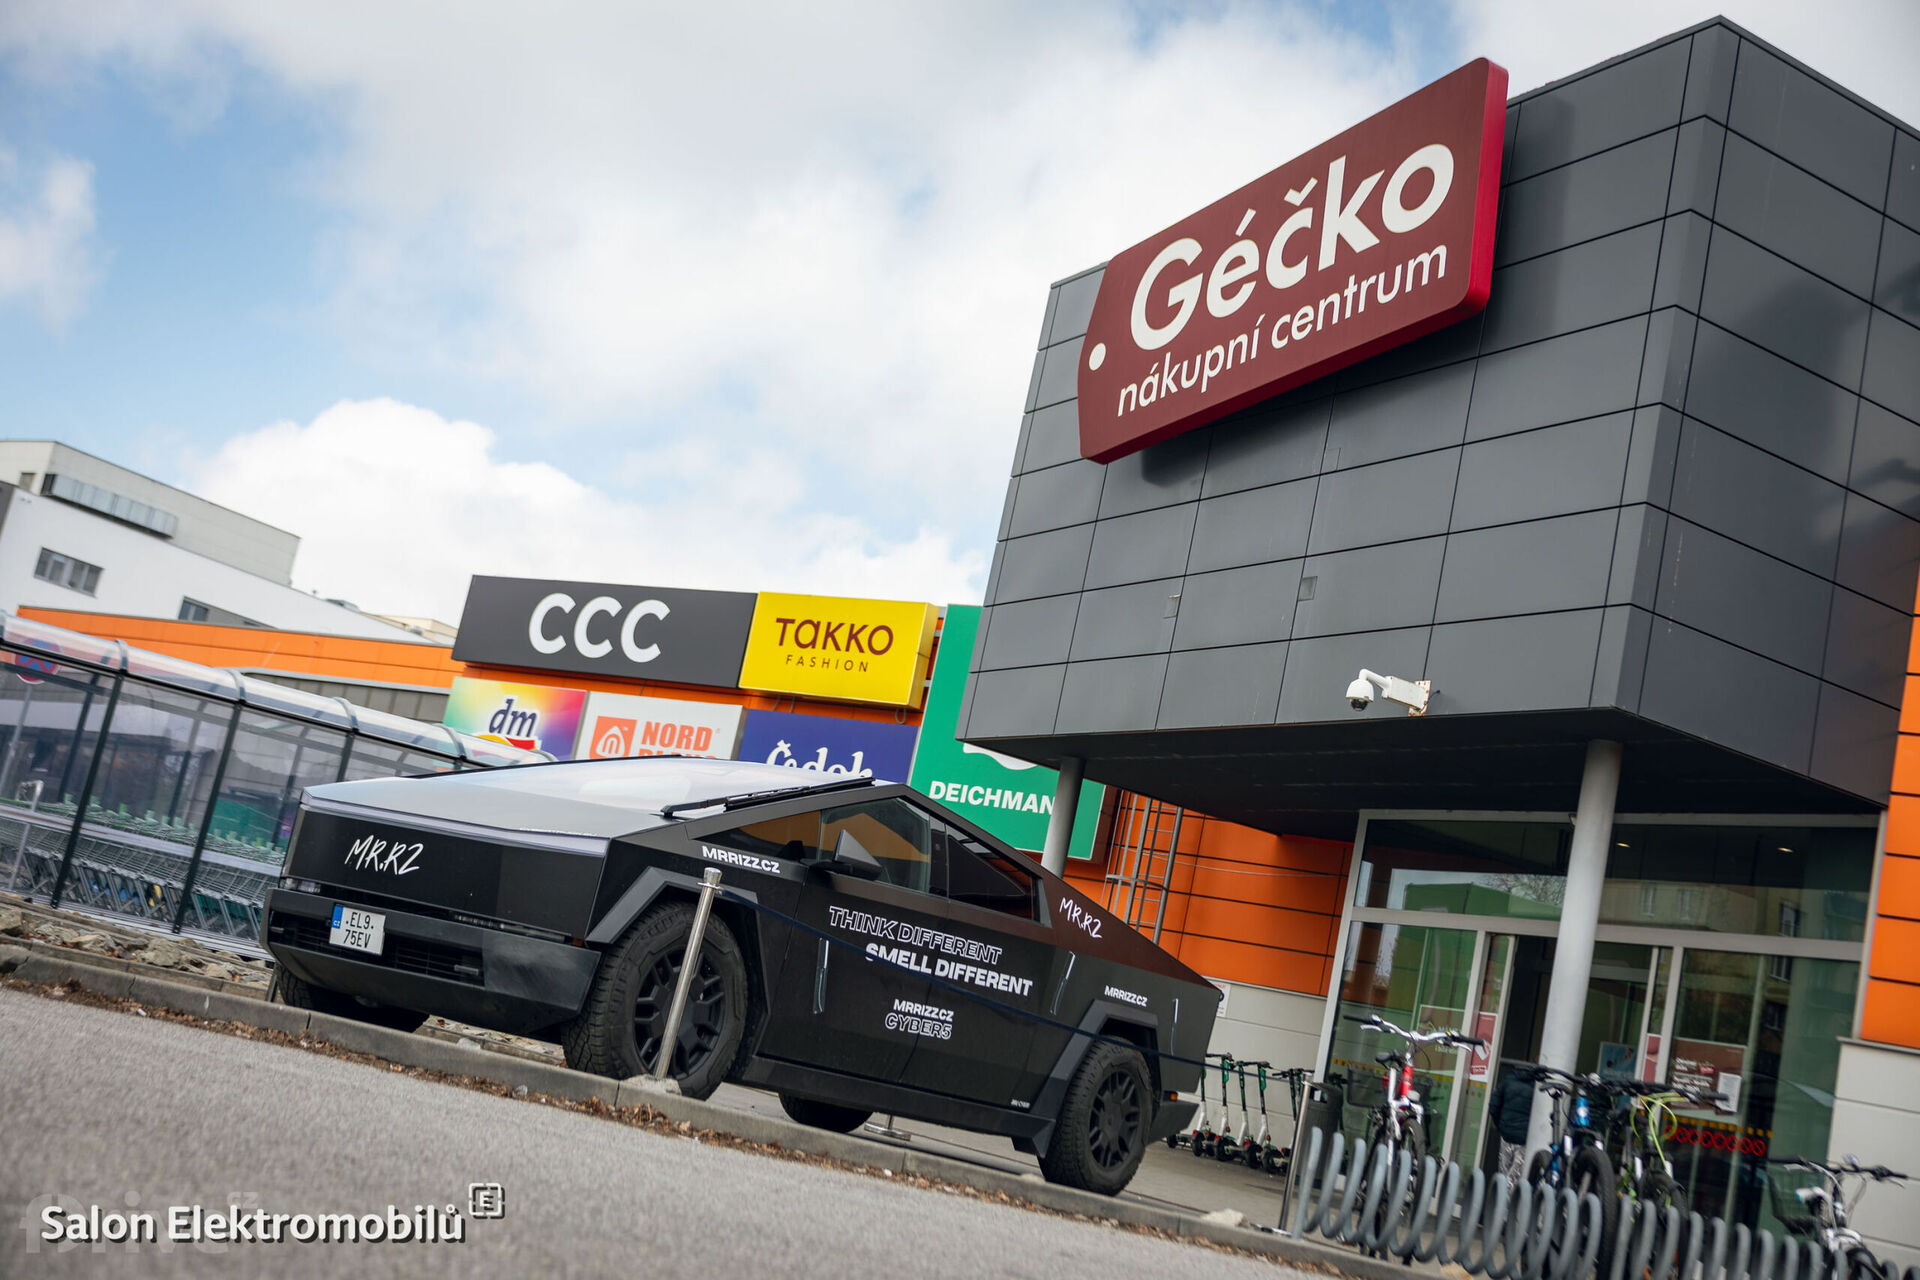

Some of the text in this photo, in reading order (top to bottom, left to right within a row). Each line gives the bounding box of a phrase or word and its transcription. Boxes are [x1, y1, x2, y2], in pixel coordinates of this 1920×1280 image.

[1130, 143, 1455, 351] Géčko
[1117, 244, 1448, 417] nákupní centrum
[528, 592, 671, 663] CCC
[785, 654, 869, 673] FASHION
[488, 698, 538, 738] dm
[641, 721, 713, 752] NORD
[928, 780, 1056, 816] DEICHMAN
[343, 929, 371, 949] 75EV
[829, 905, 1002, 965] THINK DIFFERENT
[865, 942, 1034, 997] SMELL DIFFERENT
